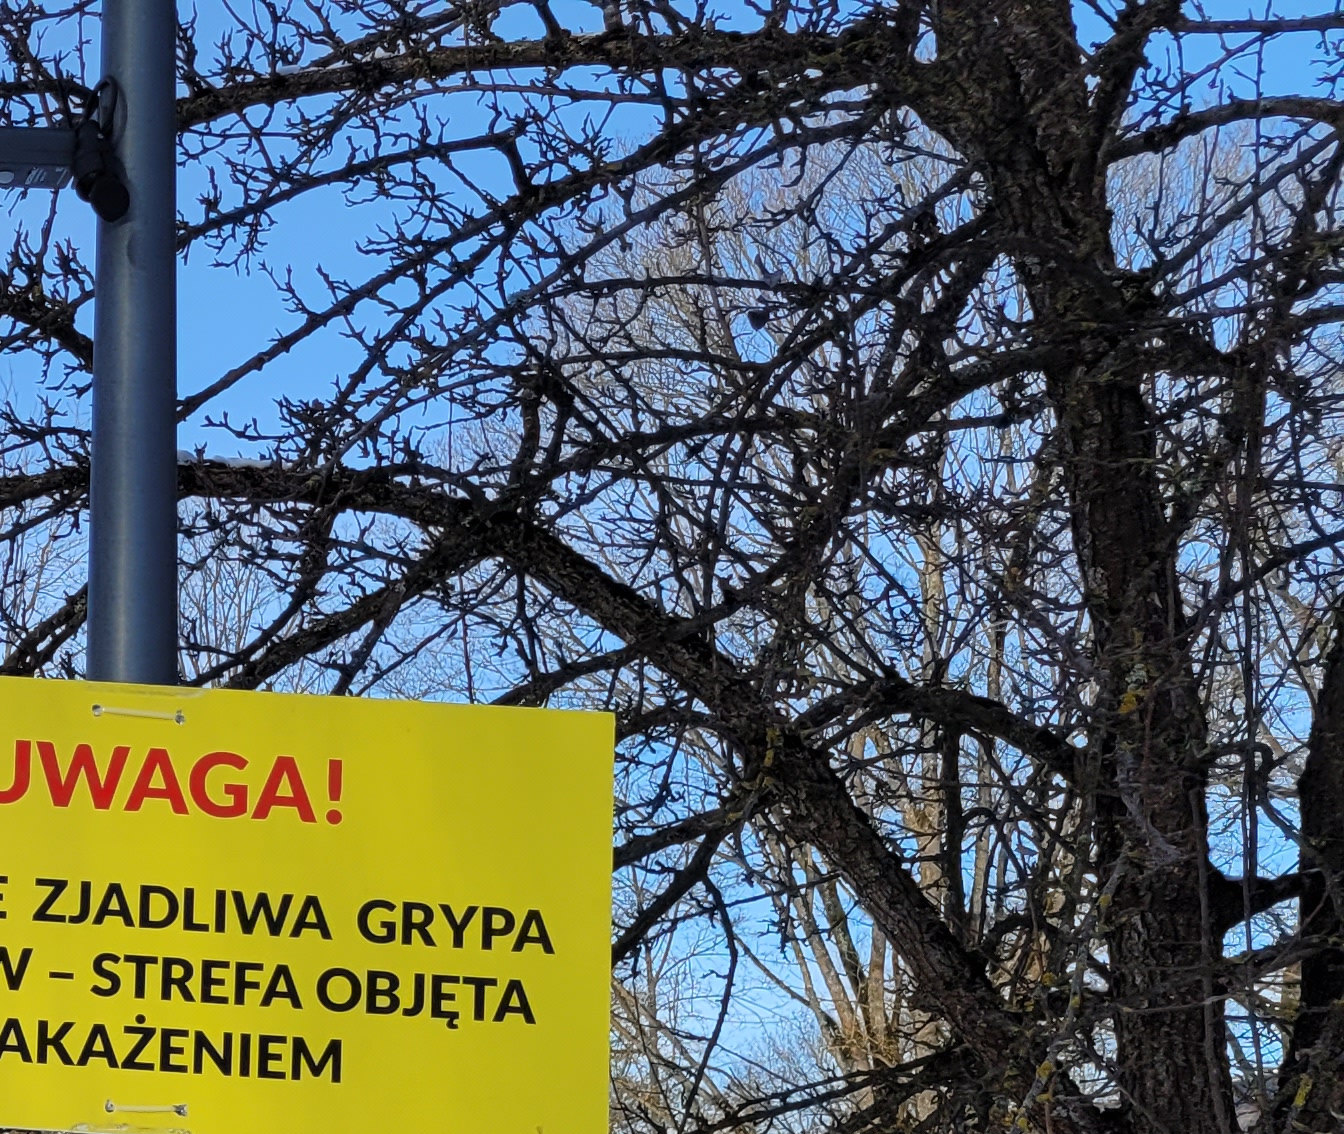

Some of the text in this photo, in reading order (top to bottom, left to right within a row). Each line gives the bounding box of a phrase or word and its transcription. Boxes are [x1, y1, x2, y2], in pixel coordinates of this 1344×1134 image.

[31, 876, 334, 942] ZJADLIWA
[356, 898, 556, 956] GRYPA
[89, 951, 304, 1011] STREFA
[315, 966, 538, 1031] OBJĘTA
